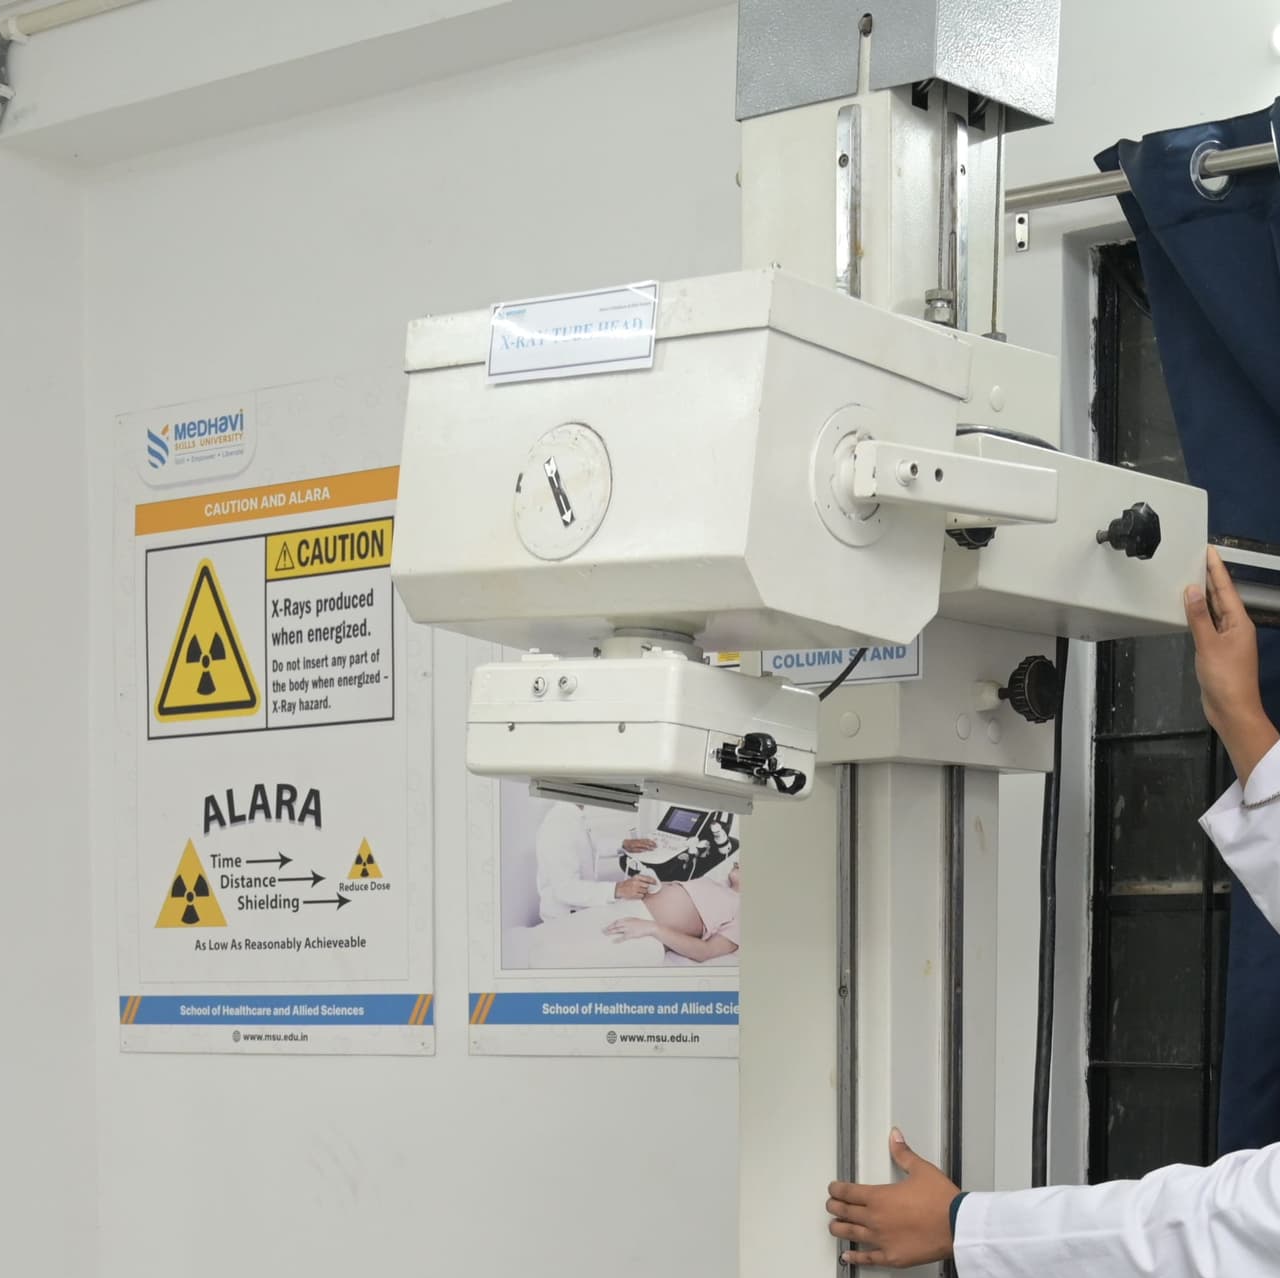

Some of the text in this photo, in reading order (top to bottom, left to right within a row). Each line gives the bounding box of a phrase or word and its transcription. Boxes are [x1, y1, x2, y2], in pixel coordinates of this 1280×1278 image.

[200, 433, 244, 447] UNIVERSITY
[204, 486, 331, 517] CAUTION AND ALARA
[296, 528, 385, 567] CAUTION
[271, 587, 374, 620] X-Rays produced
[271, 617, 372, 647] when energized.
[272, 648, 380, 673] Do not insert any part of
[772, 649, 844, 669] COLUMN
[272, 679, 286, 693] the
[289, 676, 310, 694] body
[311, 674, 335, 690] when
[337, 670, 381, 688] energized
[272, 696, 332, 715] X-Ray hazard.
[203, 783, 323, 835] ALARA
[210, 853, 242, 869] Time
[220, 874, 277, 889] Distance
[339, 881, 391, 892] Reduce Dose
[237, 894, 300, 913] Shielding
[194, 936, 367, 952] As Low As Reasonably Achieveable
[179, 1004, 365, 1016] School of Healthcare and Allied Sciences
[542, 1002, 580, 1015] School
[581, 1002, 592, 1015] of
[594, 1002, 654, 1015] Healthcare
[657, 1002, 678, 1015] and
[681, 1002, 713, 1015] Allied
[243, 1032, 308, 1042] www.msu.edu.in
[620, 1032, 700, 1043] www.msu.edu.in
